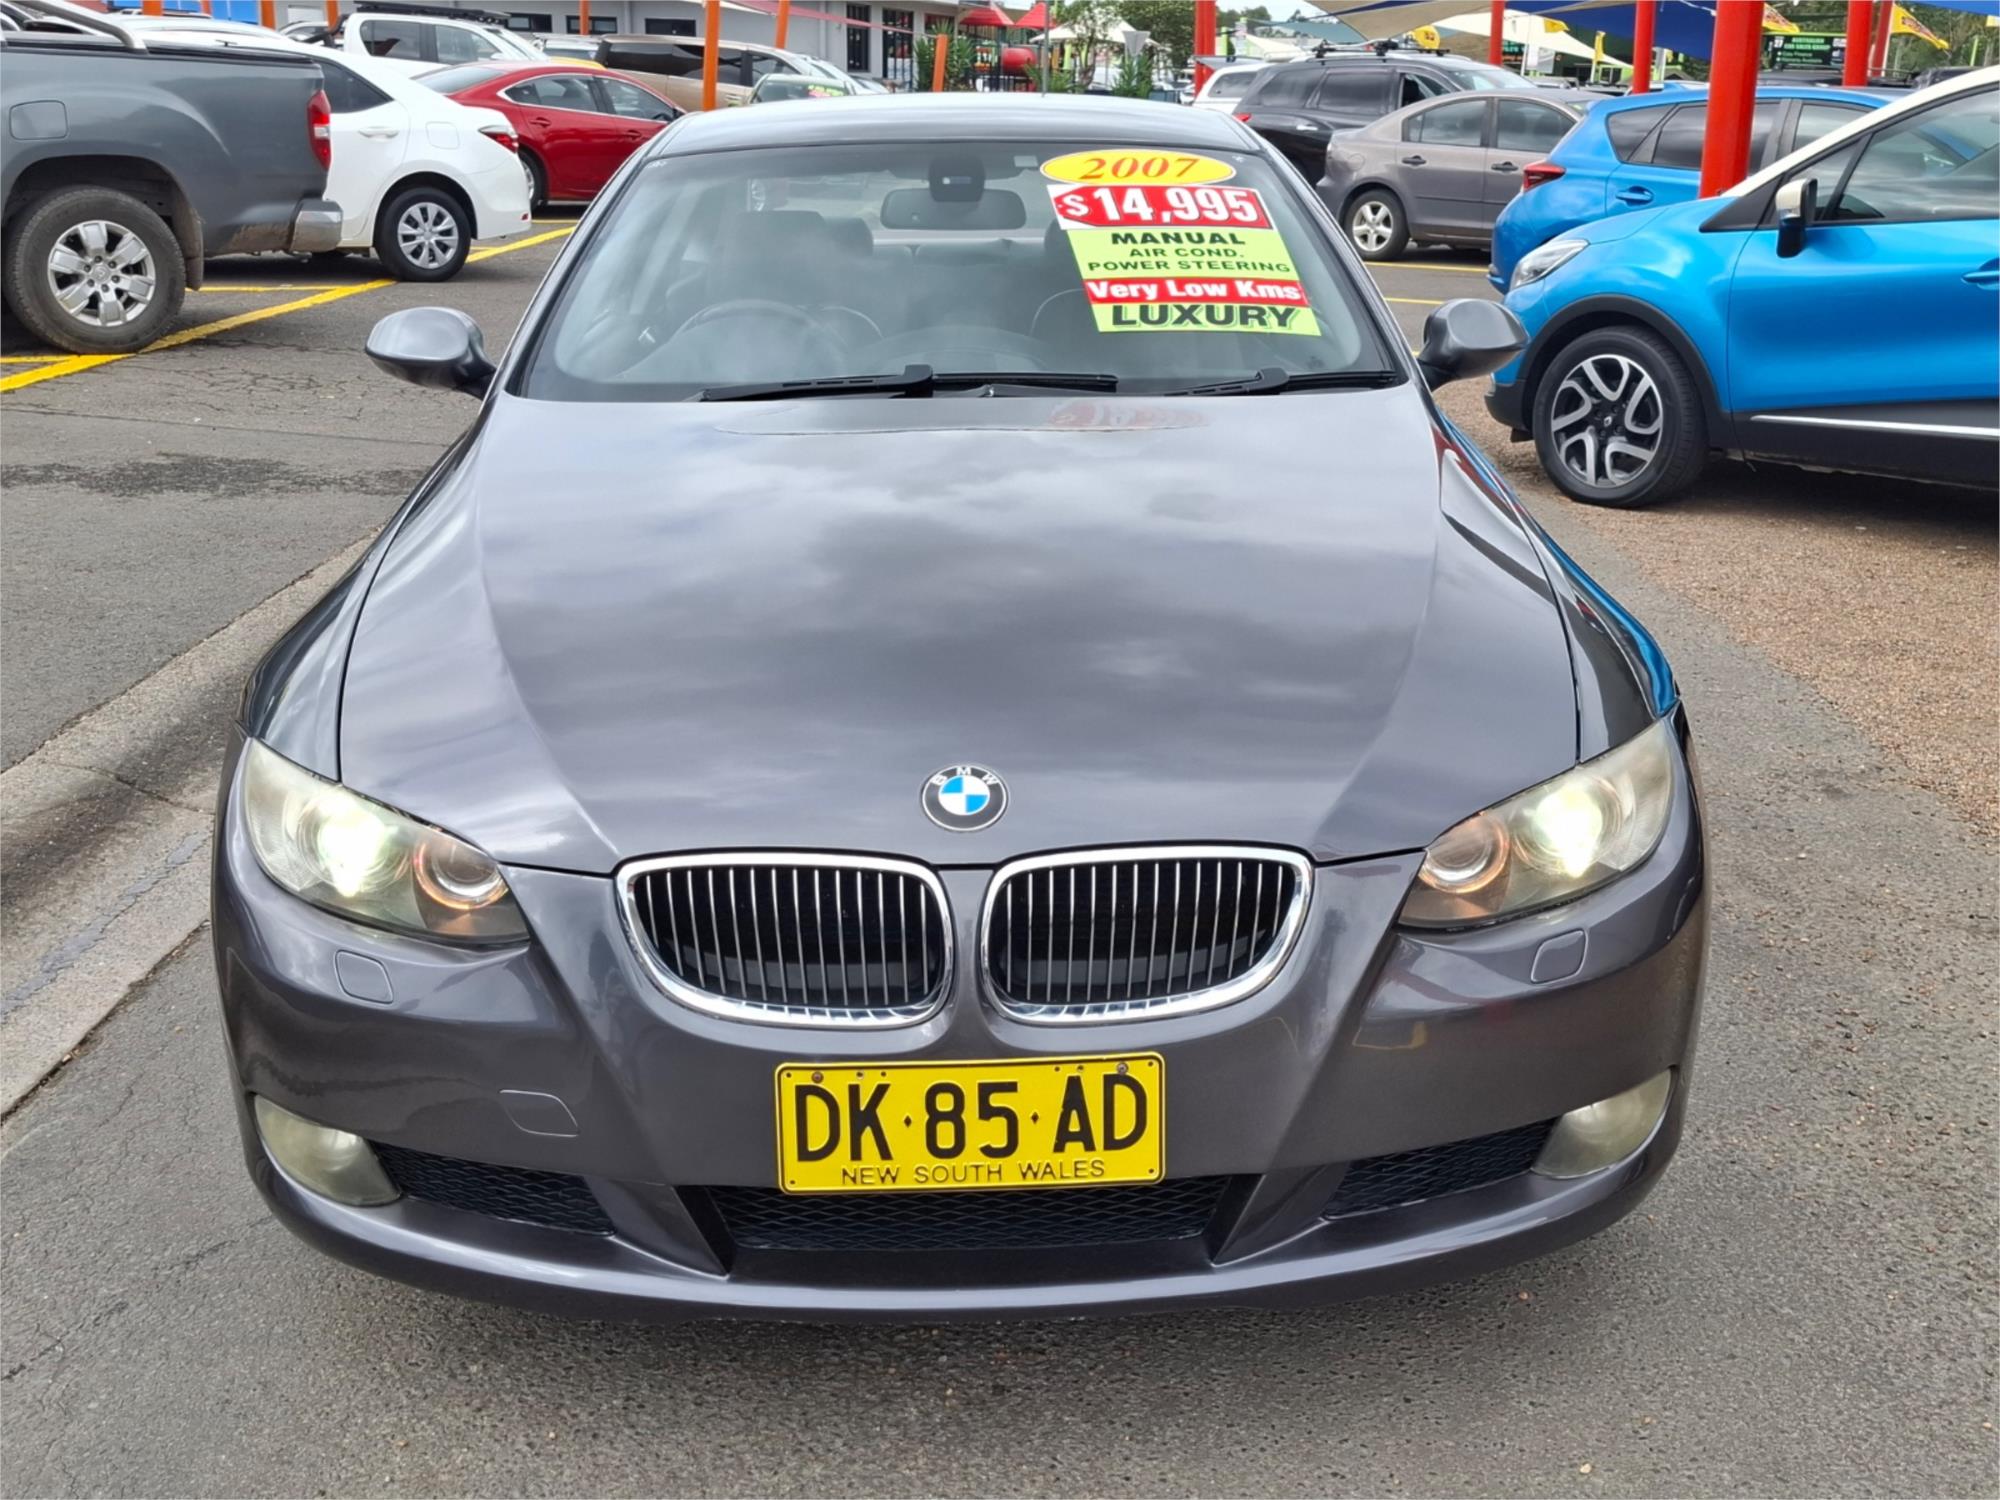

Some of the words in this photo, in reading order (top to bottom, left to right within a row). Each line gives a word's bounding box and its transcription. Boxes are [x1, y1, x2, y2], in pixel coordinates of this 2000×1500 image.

[1080, 157, 1200, 179] 2007
[1065, 187, 1259, 223] $14,995
[1111, 232, 1246, 245] MANUAL
[1129, 248, 1167, 257] AIR
[1174, 248, 1244, 258] COND.
[1088, 261, 1170, 272] POWER
[1179, 260, 1291, 273] STEERING
[1088, 280, 1159, 300] Very
[1165, 280, 1228, 298] Low
[1235, 280, 1302, 300] Kms
[1112, 304, 1299, 329] LUXURY
[930, 765, 1000, 786] BMW
[795, 1083, 893, 1162] DK
[925, 1081, 1019, 1159] 85
[1053, 1073, 1147, 1153] AD
[841, 1166, 900, 1185] NEW
[914, 1162, 1002, 1183] SOUTH
[1020, 1159, 1105, 1180] WALES
